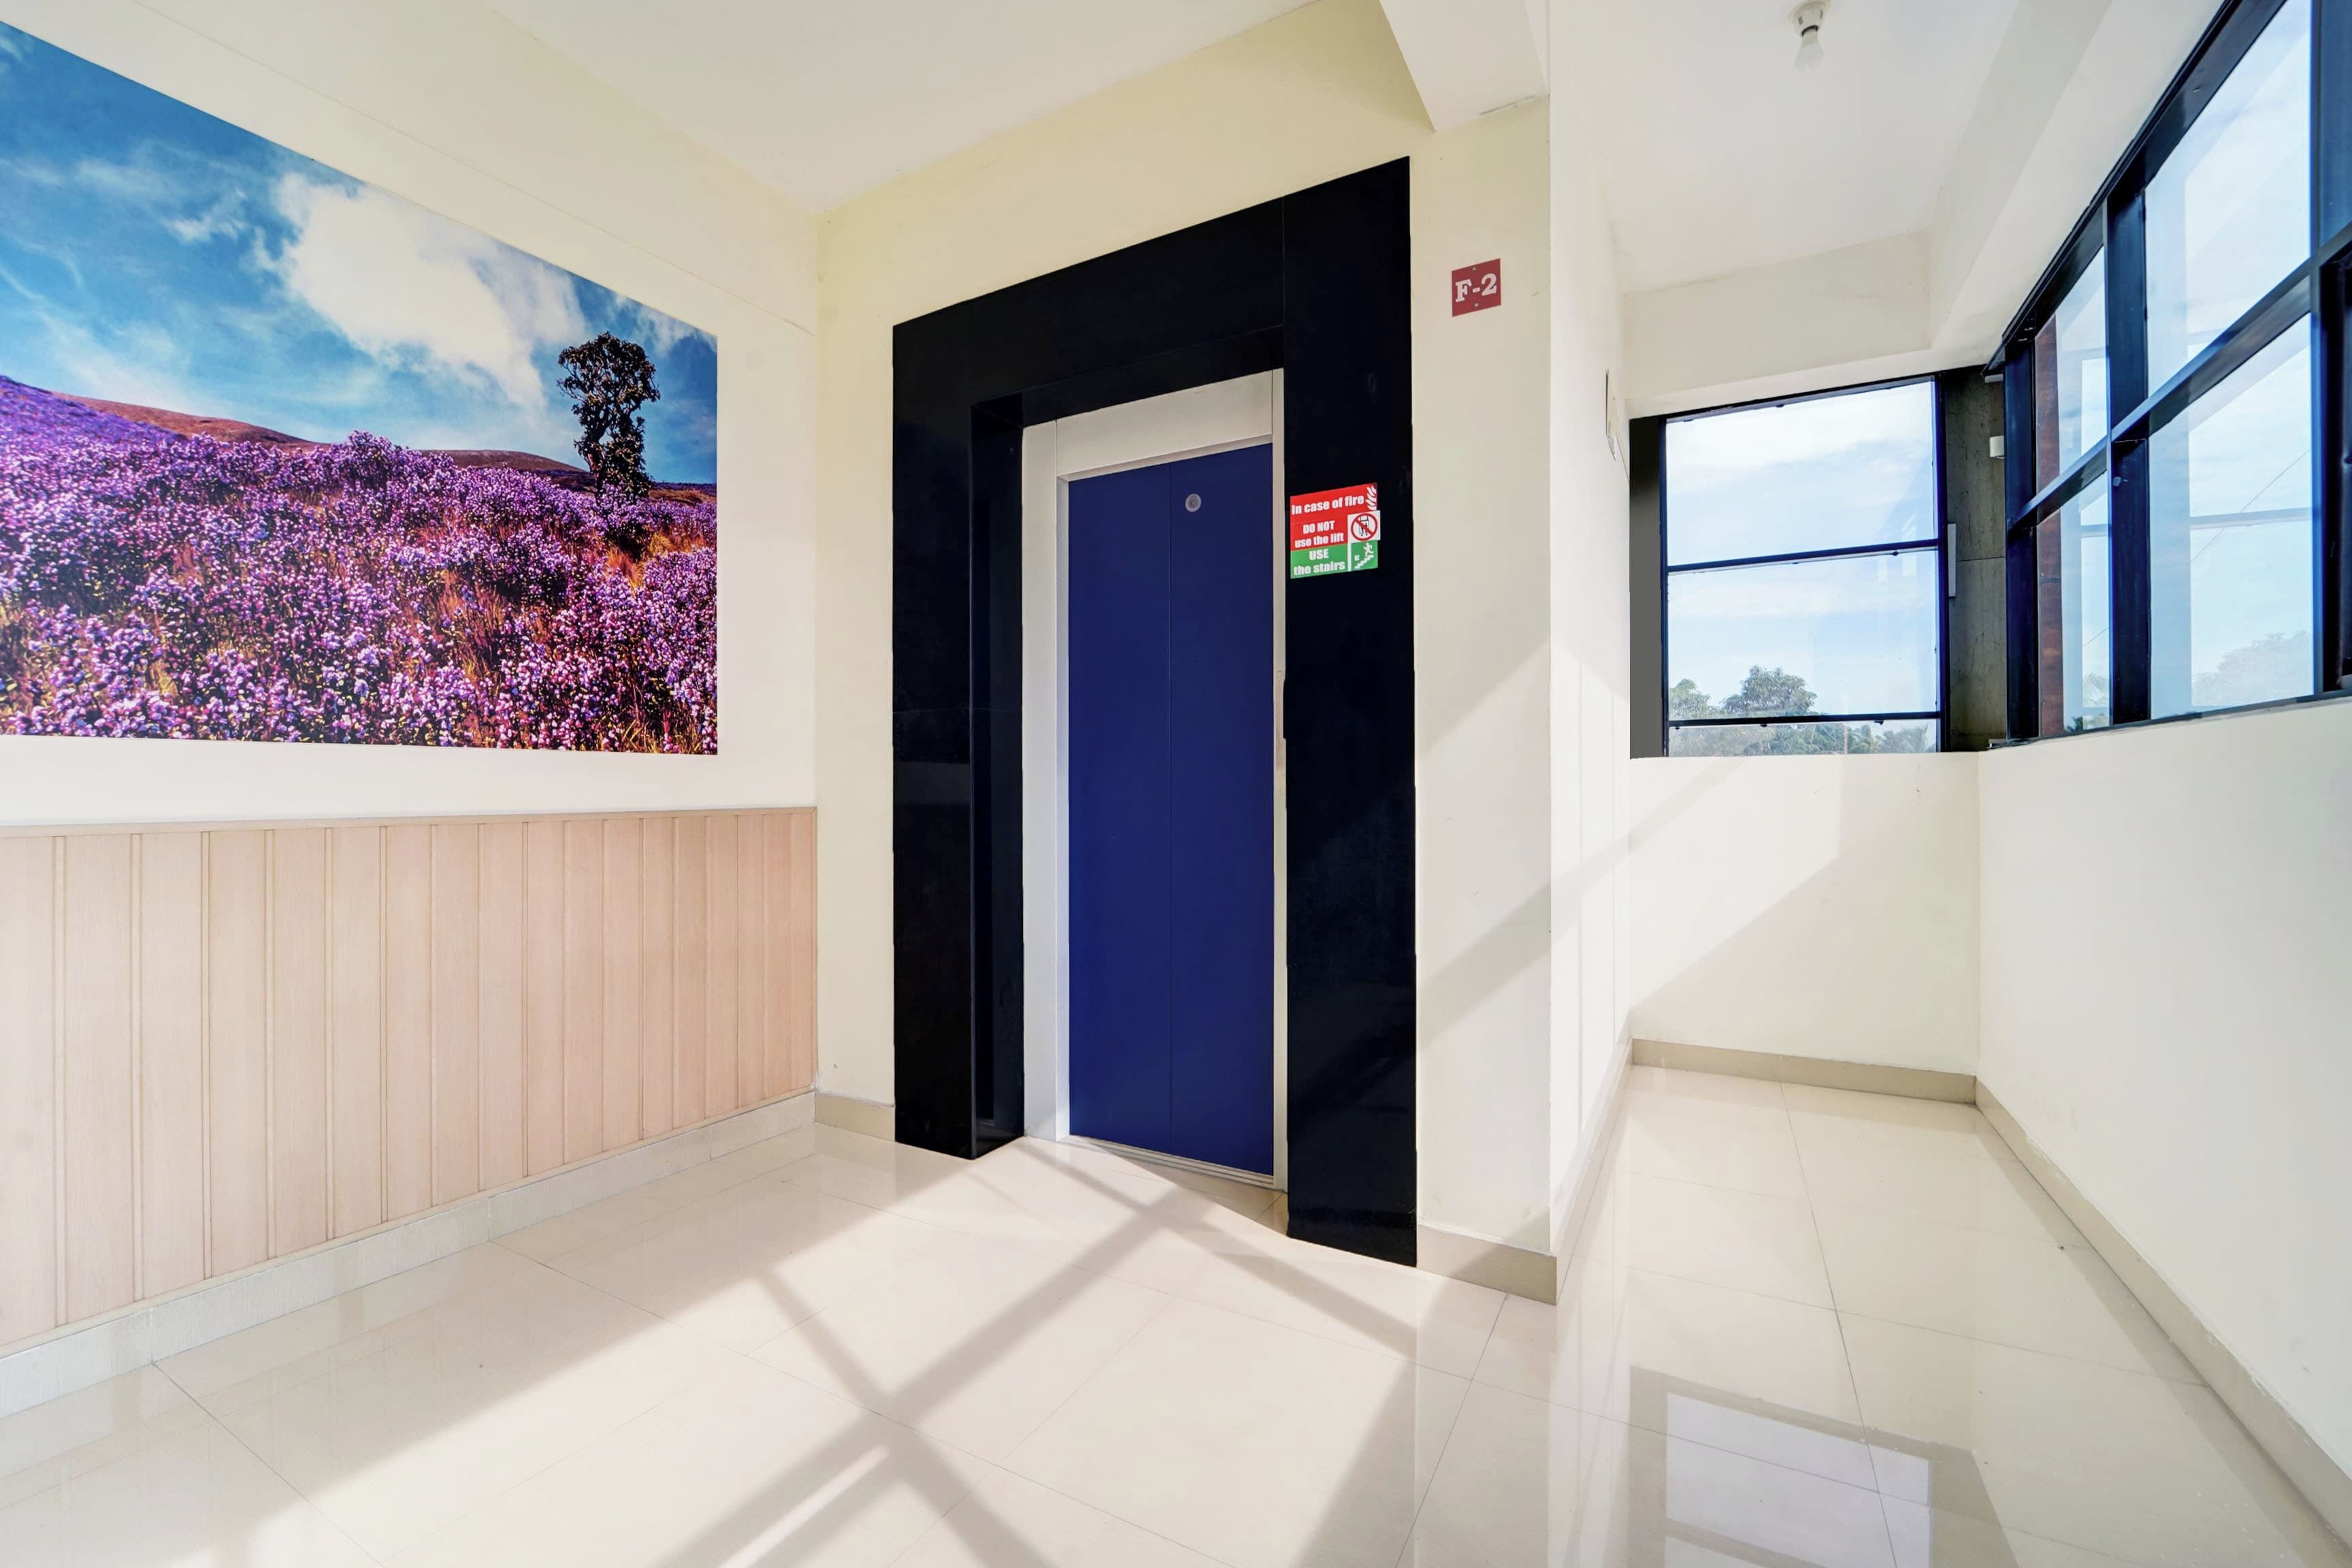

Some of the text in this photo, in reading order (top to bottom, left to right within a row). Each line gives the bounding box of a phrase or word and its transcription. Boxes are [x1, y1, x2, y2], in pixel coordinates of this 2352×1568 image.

[1455, 273, 1497, 303] F-2
[1292, 495, 1365, 515] In case of fire
[1303, 521, 1335, 534] DO NOT
[1294, 532, 1344, 548] use the lift
[1309, 549, 1328, 560] USE
[1294, 561, 1345, 576] the stairs
